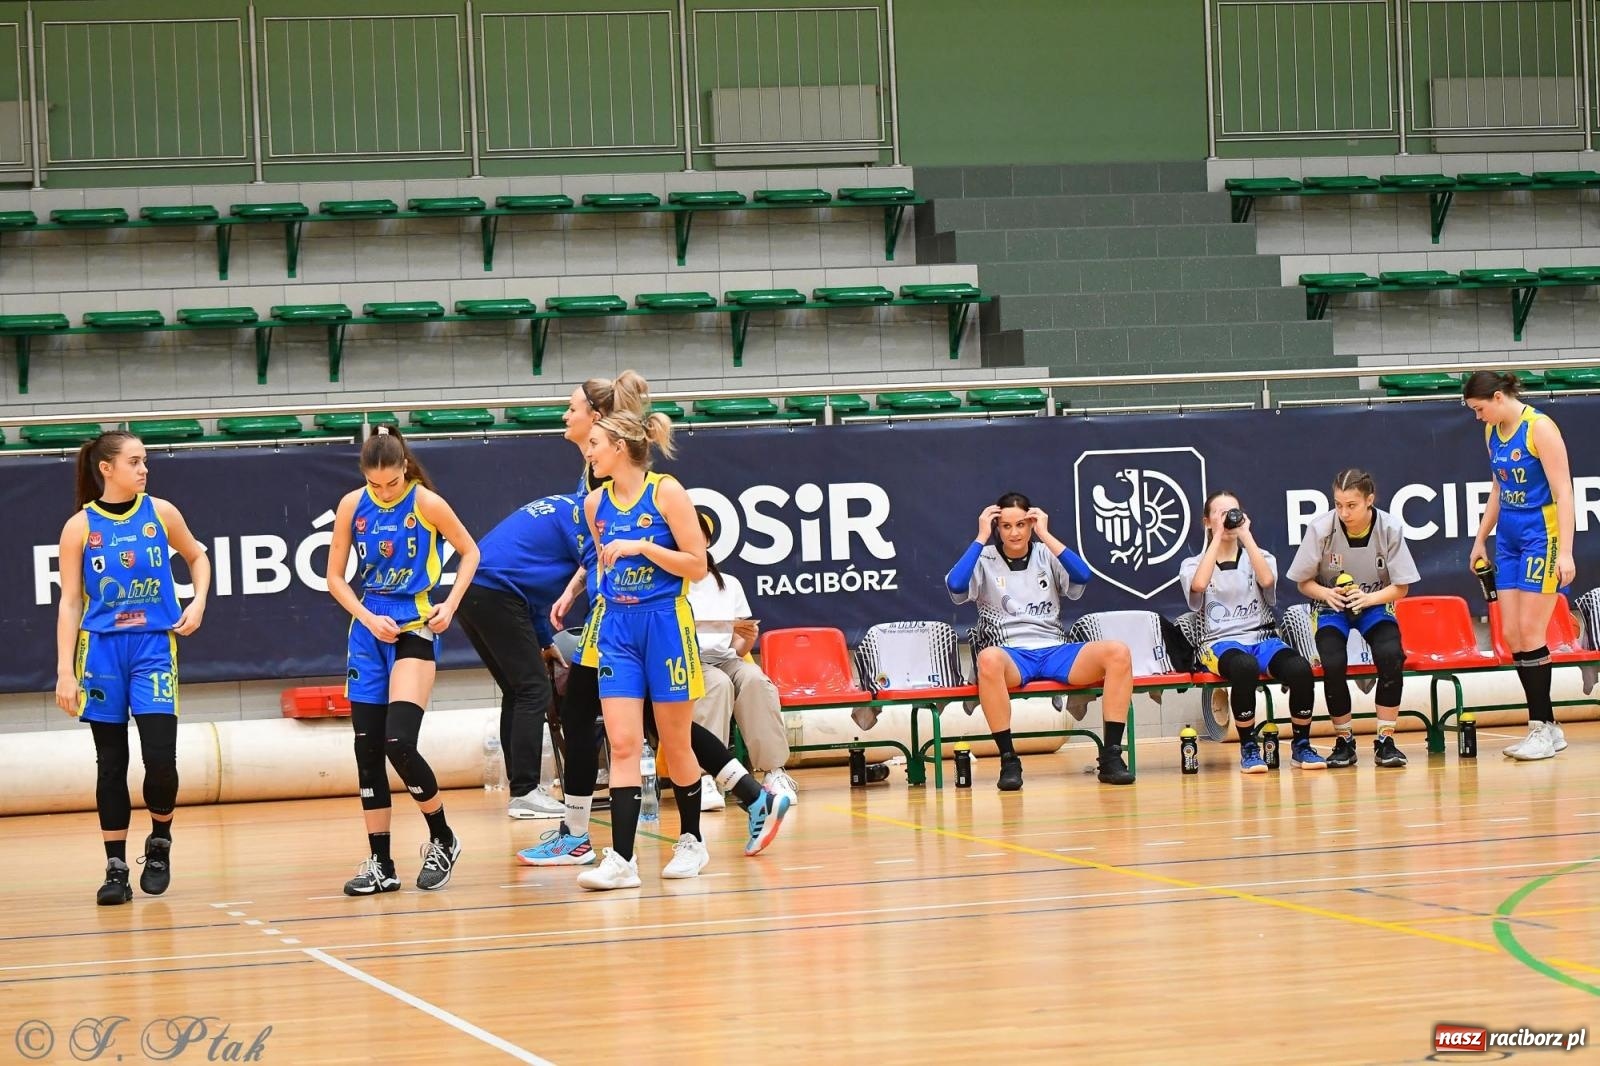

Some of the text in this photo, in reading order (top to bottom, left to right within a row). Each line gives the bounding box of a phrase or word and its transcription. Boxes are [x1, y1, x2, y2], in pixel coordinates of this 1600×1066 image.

[1511, 467, 1527, 485] 12
[684, 482, 896, 565] OSiR
[146, 546, 162, 568] 13
[407, 537, 417, 558] 5
[756, 564, 898, 596] RACIBÓRZ
[1525, 556, 1545, 580] 12
[665, 656, 687, 686] 16
[149, 672, 173, 698] 13
